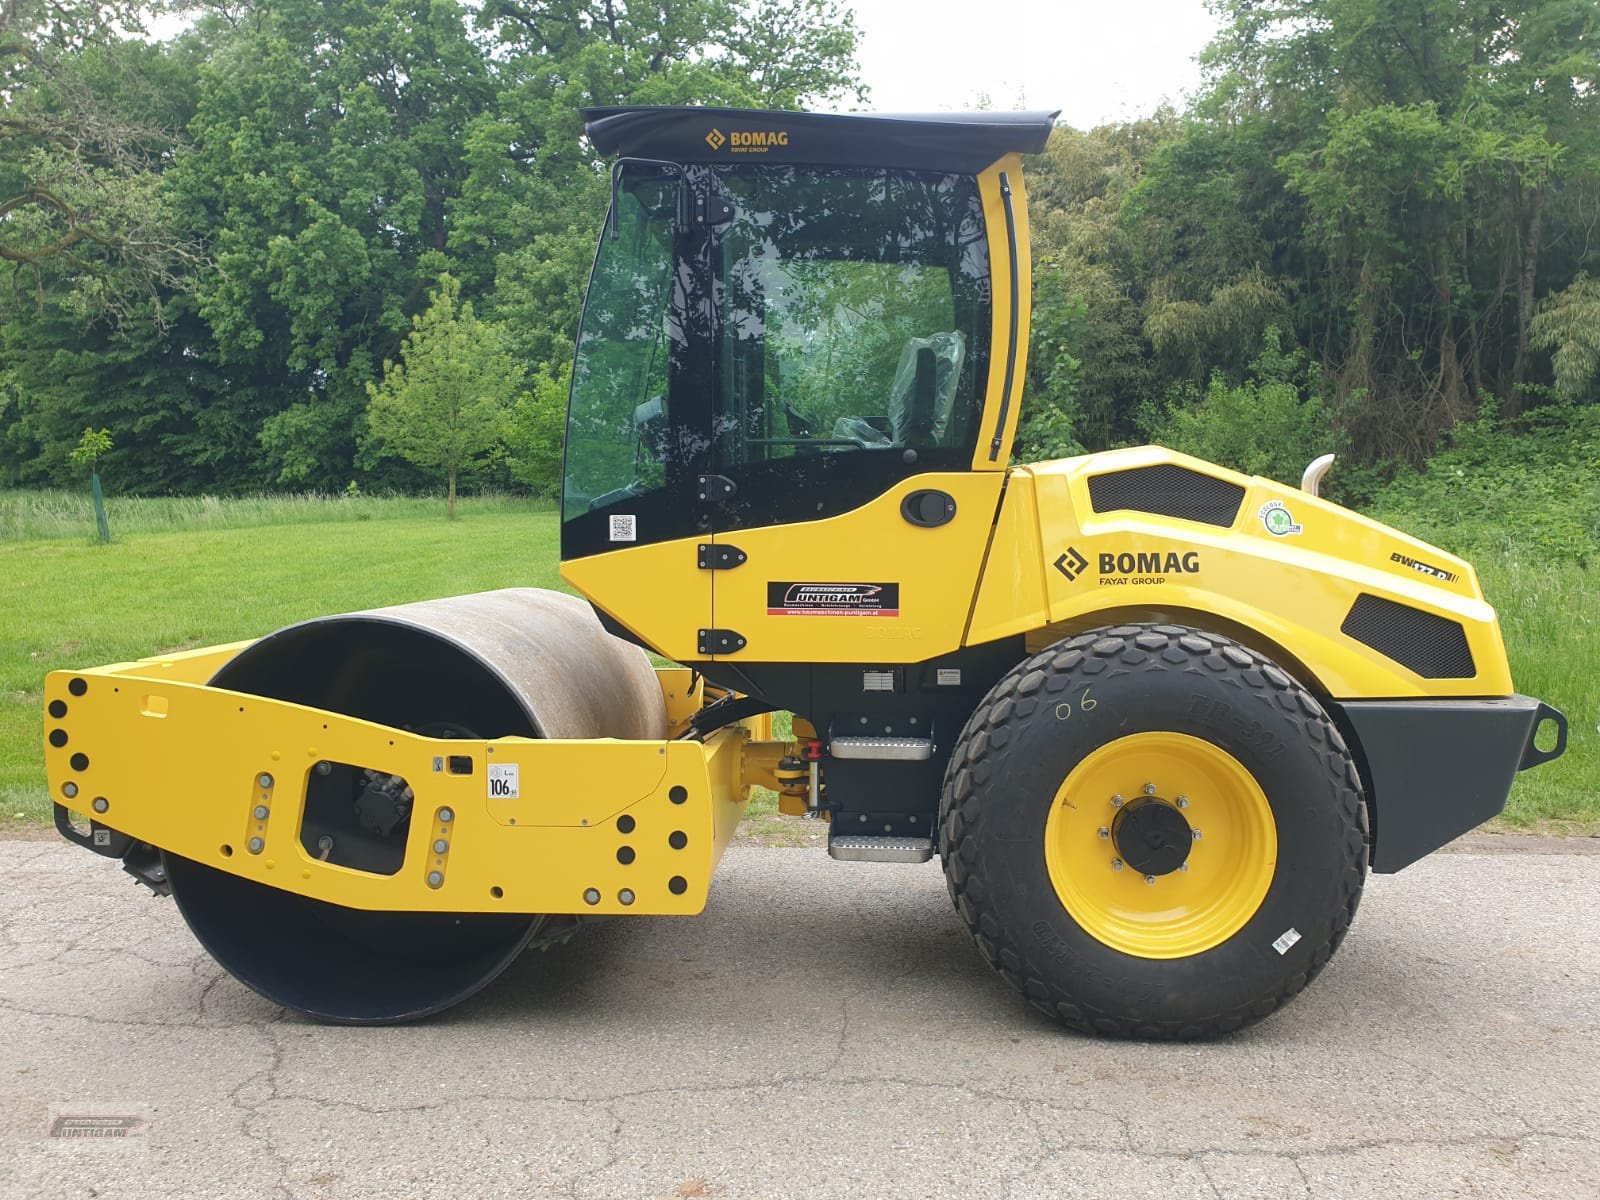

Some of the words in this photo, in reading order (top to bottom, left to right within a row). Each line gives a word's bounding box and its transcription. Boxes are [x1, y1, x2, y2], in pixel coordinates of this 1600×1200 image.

[730, 131, 789, 146] BOMAG
[1098, 551, 1200, 574] BOMAG
[1099, 577, 1129, 585] FAYAT
[1131, 577, 1166, 585] GROUP
[490, 778, 510, 796] 106
